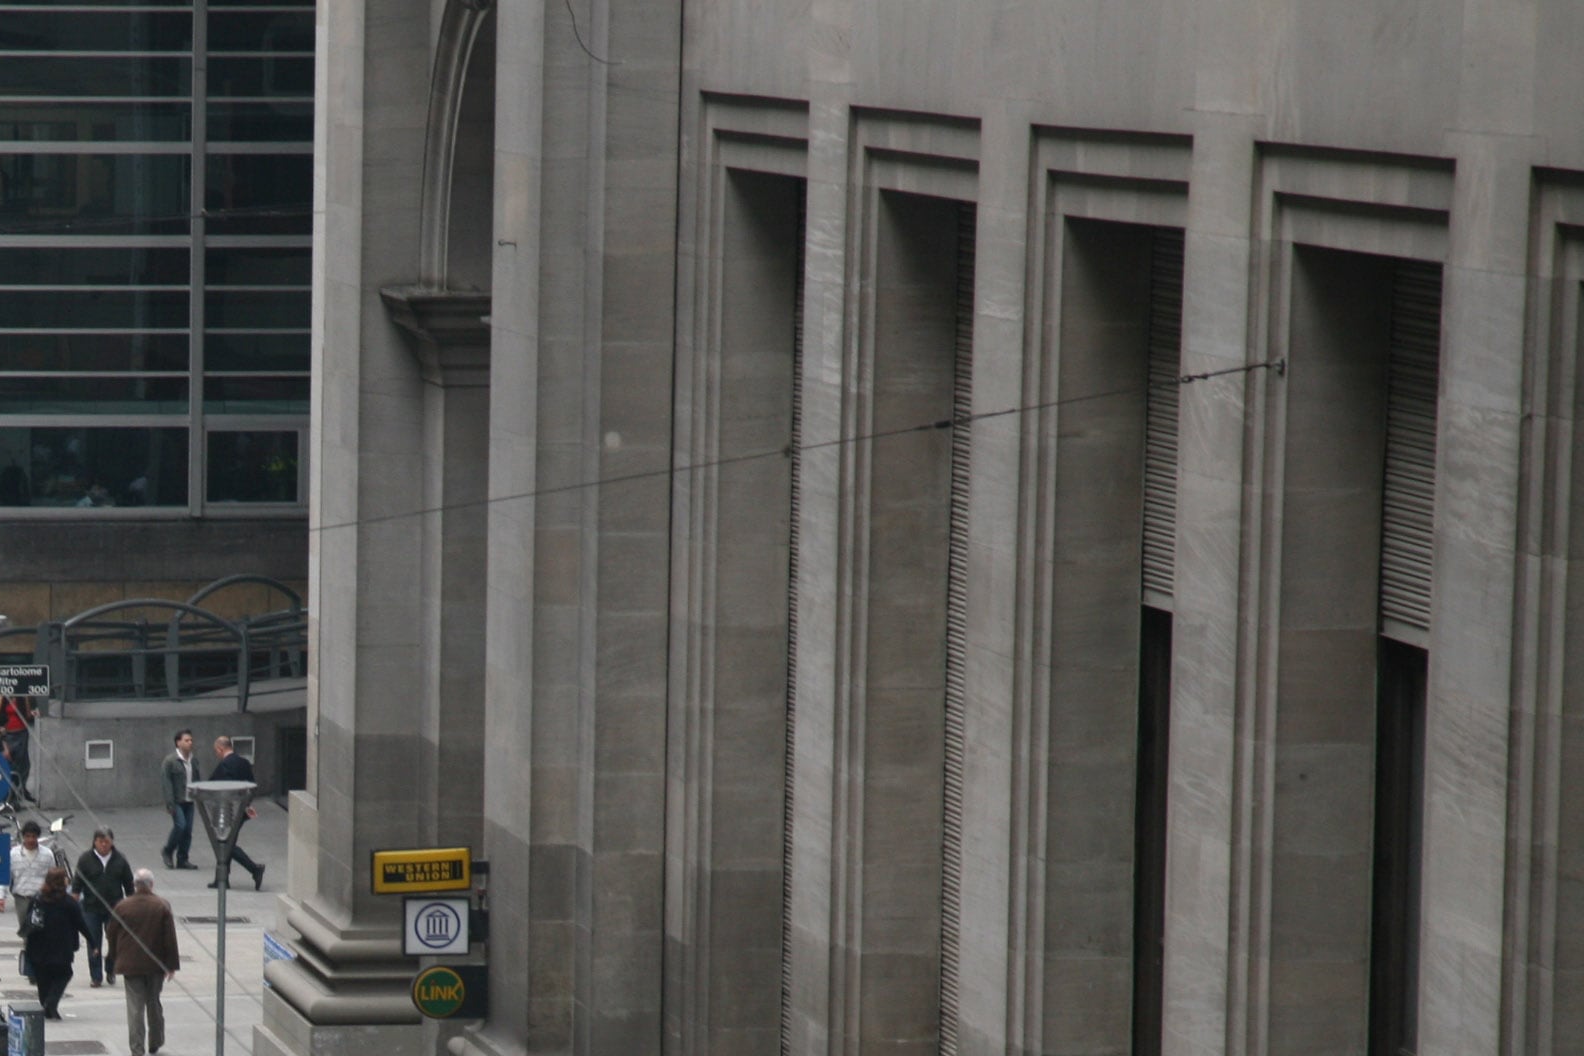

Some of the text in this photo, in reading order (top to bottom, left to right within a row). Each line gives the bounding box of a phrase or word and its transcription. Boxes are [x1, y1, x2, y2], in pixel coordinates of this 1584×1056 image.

[28, 685, 47, 695] 300
[385, 861, 450, 873] WESTERN
[406, 871, 450, 882] UNION
[421, 981, 462, 1001] LINK
